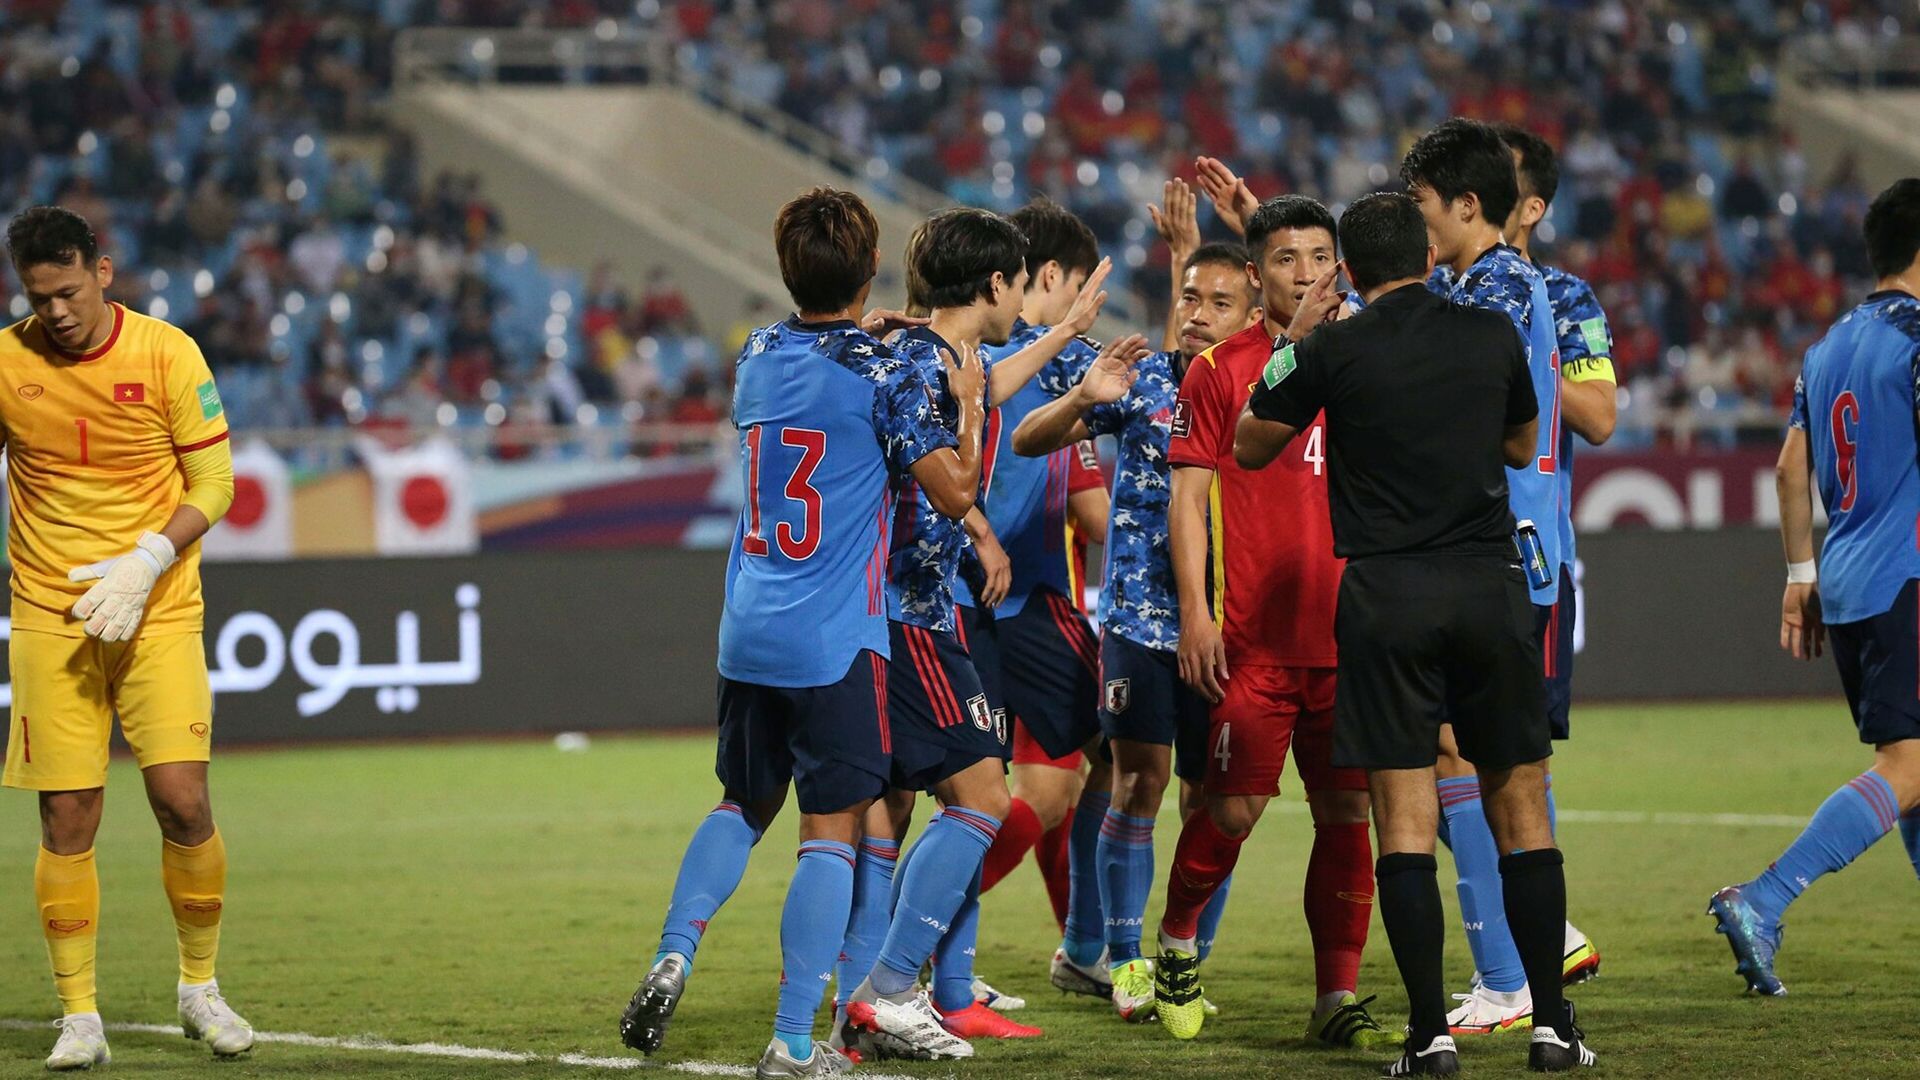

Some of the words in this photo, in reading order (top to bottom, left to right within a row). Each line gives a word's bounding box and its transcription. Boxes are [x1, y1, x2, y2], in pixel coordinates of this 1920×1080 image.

[75, 418, 89, 465] 1
[1303, 425, 1324, 475] 4
[742, 424, 827, 561] 13
[21, 715, 31, 763] 1
[1214, 722, 1232, 771] 4
[1433, 1041, 1454, 1049] adidas
[1533, 1032, 1555, 1041] adidas
